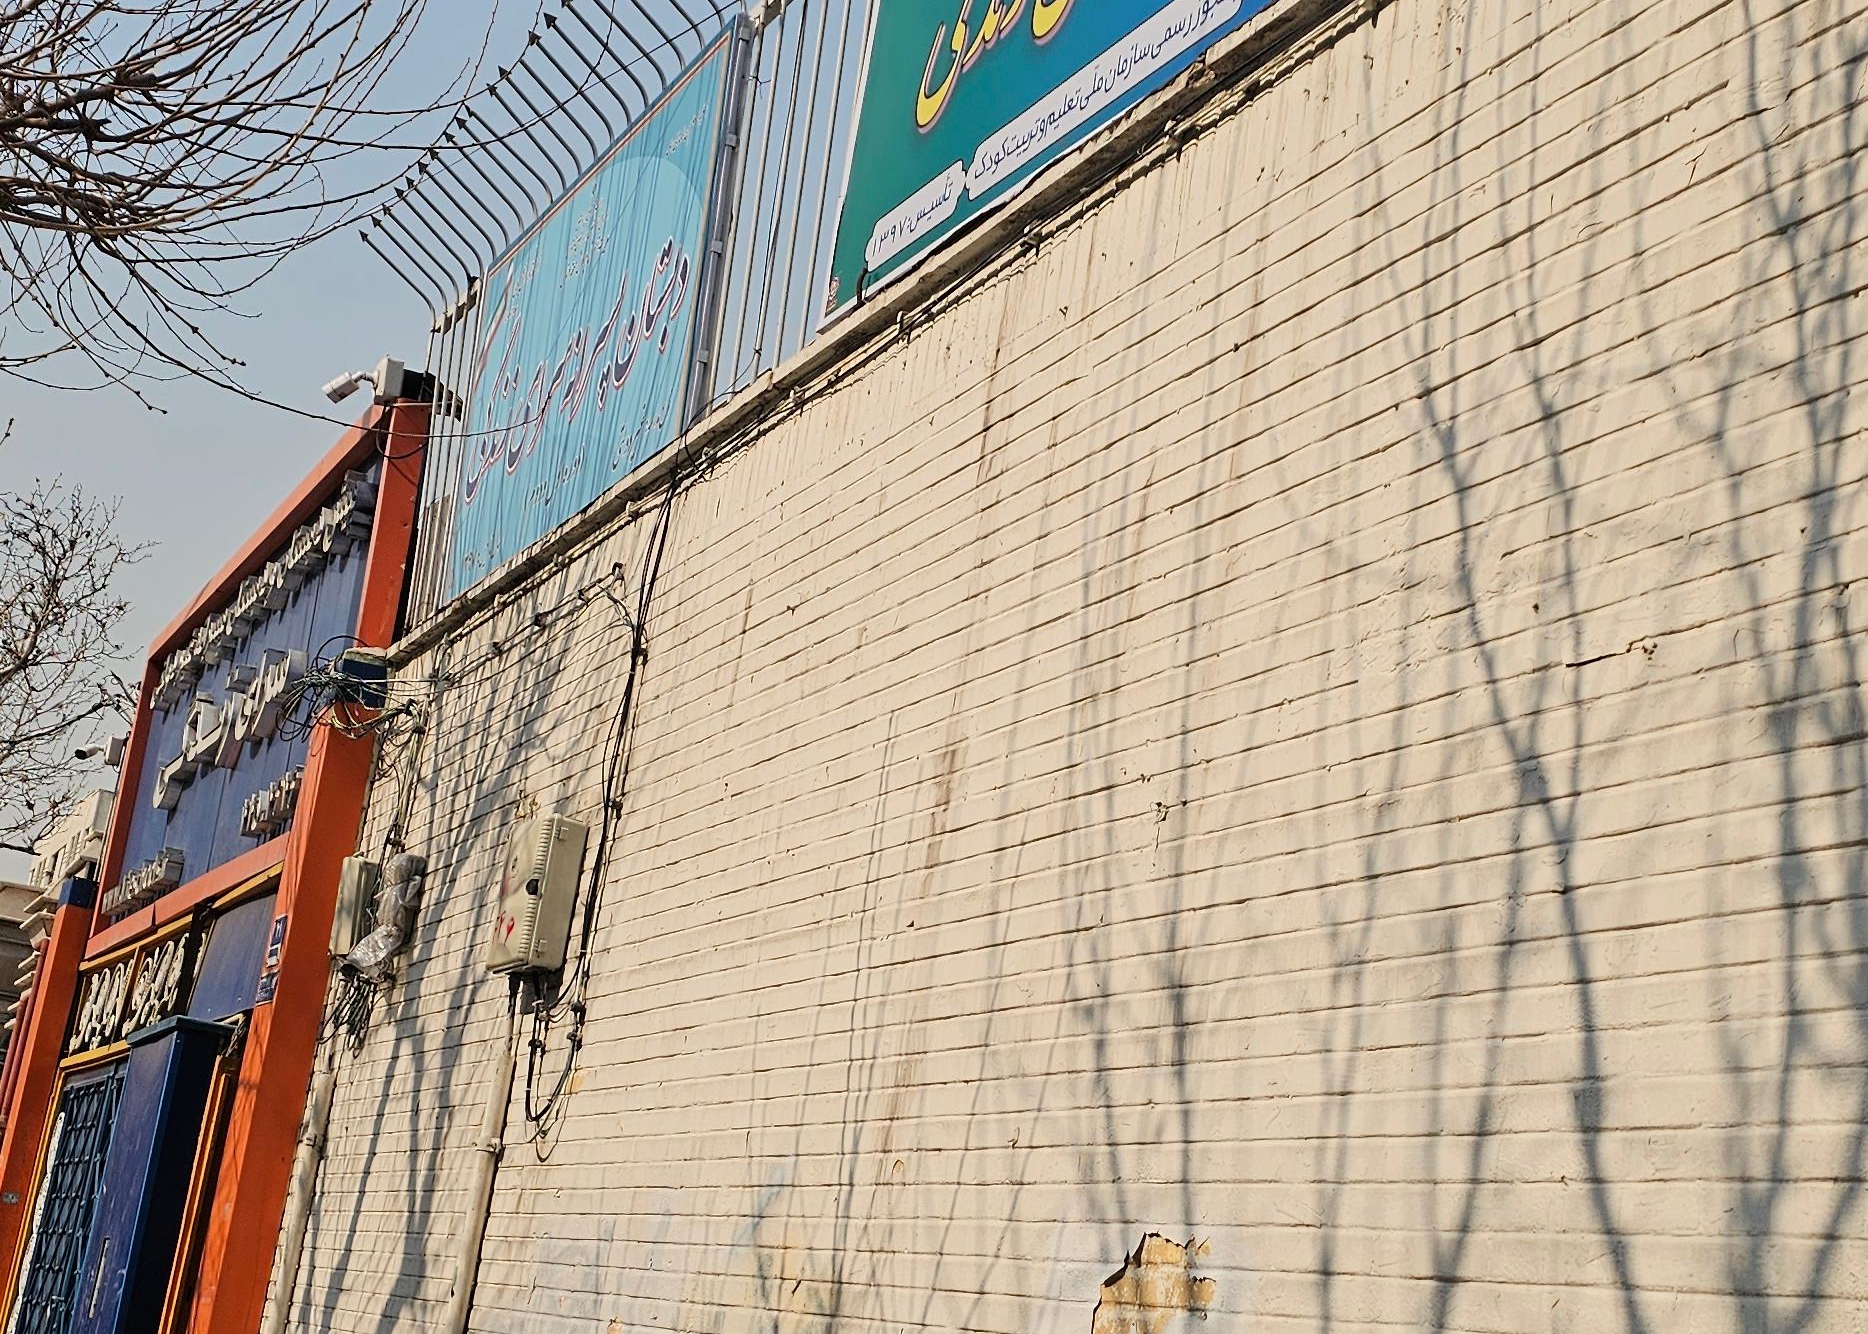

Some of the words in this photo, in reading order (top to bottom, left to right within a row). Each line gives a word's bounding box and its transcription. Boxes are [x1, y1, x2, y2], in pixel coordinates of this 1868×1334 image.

[1150, 12, 1193, 59] رسمی
[1104, 42, 1151, 93] سازمان
[1006, 117, 1041, 157] تربیت
[1043, 87, 1082, 138] تعلیم
[974, 137, 1009, 180] کودک
[872, 216, 908, 257] ۱۳۹۷
[613, 236, 690, 389] دبستان
[560, 272, 628, 425] پسرانه
[465, 314, 521, 505] زندگی
[507, 334, 577, 475] سرای
[233, 649, 290, 740] سرای
